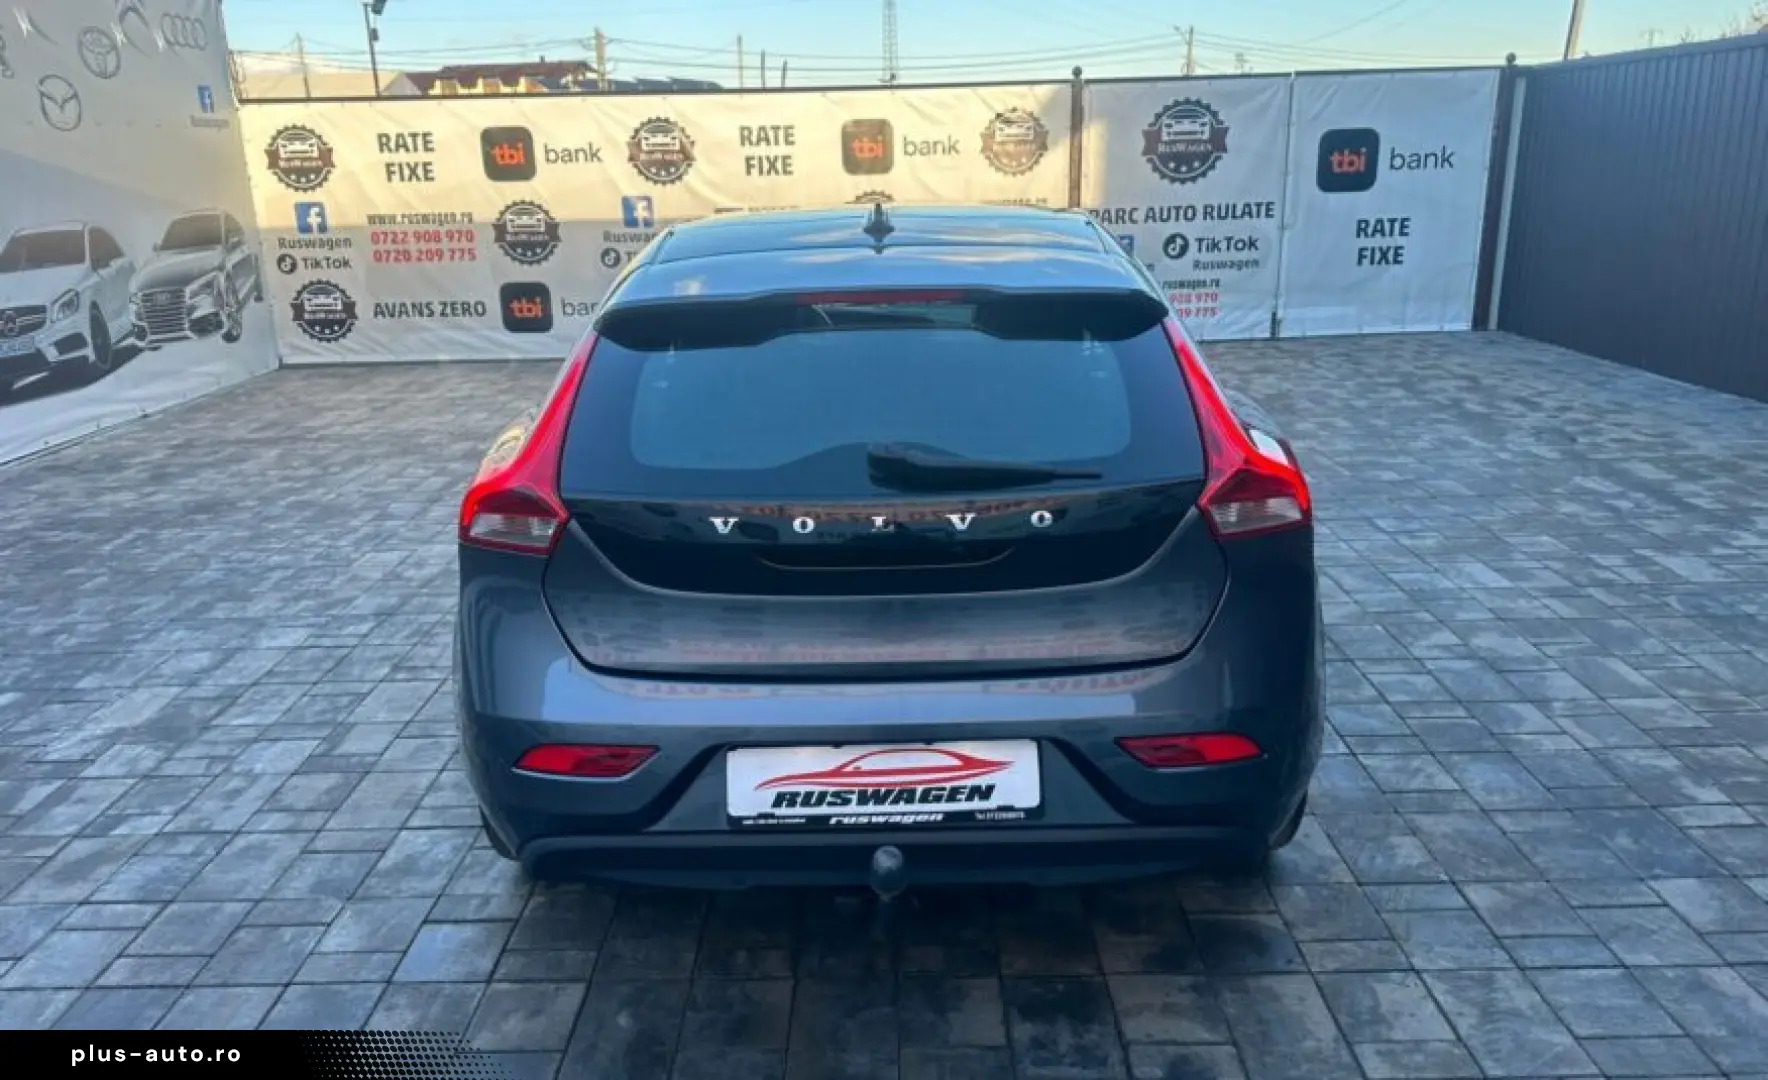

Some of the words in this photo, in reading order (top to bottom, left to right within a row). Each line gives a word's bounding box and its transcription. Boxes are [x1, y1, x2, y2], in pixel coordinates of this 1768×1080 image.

[376, 131, 436, 154] RATE
[739, 124, 796, 147] RATE
[491, 140, 526, 165] tbi
[544, 142, 603, 164] bank
[851, 137, 883, 159] tbi
[903, 135, 961, 157] bank
[744, 155, 794, 177] FIXE
[1329, 147, 1367, 174] tbi
[1389, 145, 1456, 171] bank
[385, 161, 436, 183] FIXE
[1143, 204, 1198, 224] AUTO
[1202, 201, 1276, 222] RULATE
[371, 230, 409, 246] 0722
[446, 228, 475, 244] 970
[1355, 216, 1411, 239] RATE
[277, 236, 352, 251] Ruswagen
[448, 247, 478, 262] 775
[1195, 235, 1260, 254] TikTok
[300, 256, 353, 271] TikTok
[1193, 258, 1260, 272] Ruswagen
[1356, 245, 1405, 267] FIXE
[372, 301, 435, 319] AVANS
[439, 300, 488, 318] ZERO
[509, 295, 544, 318] tbi
[709, 500, 1054, 535] VOLVO
[770, 783, 996, 809] RUSWAGEN
[828, 812, 945, 825] ruswagen
